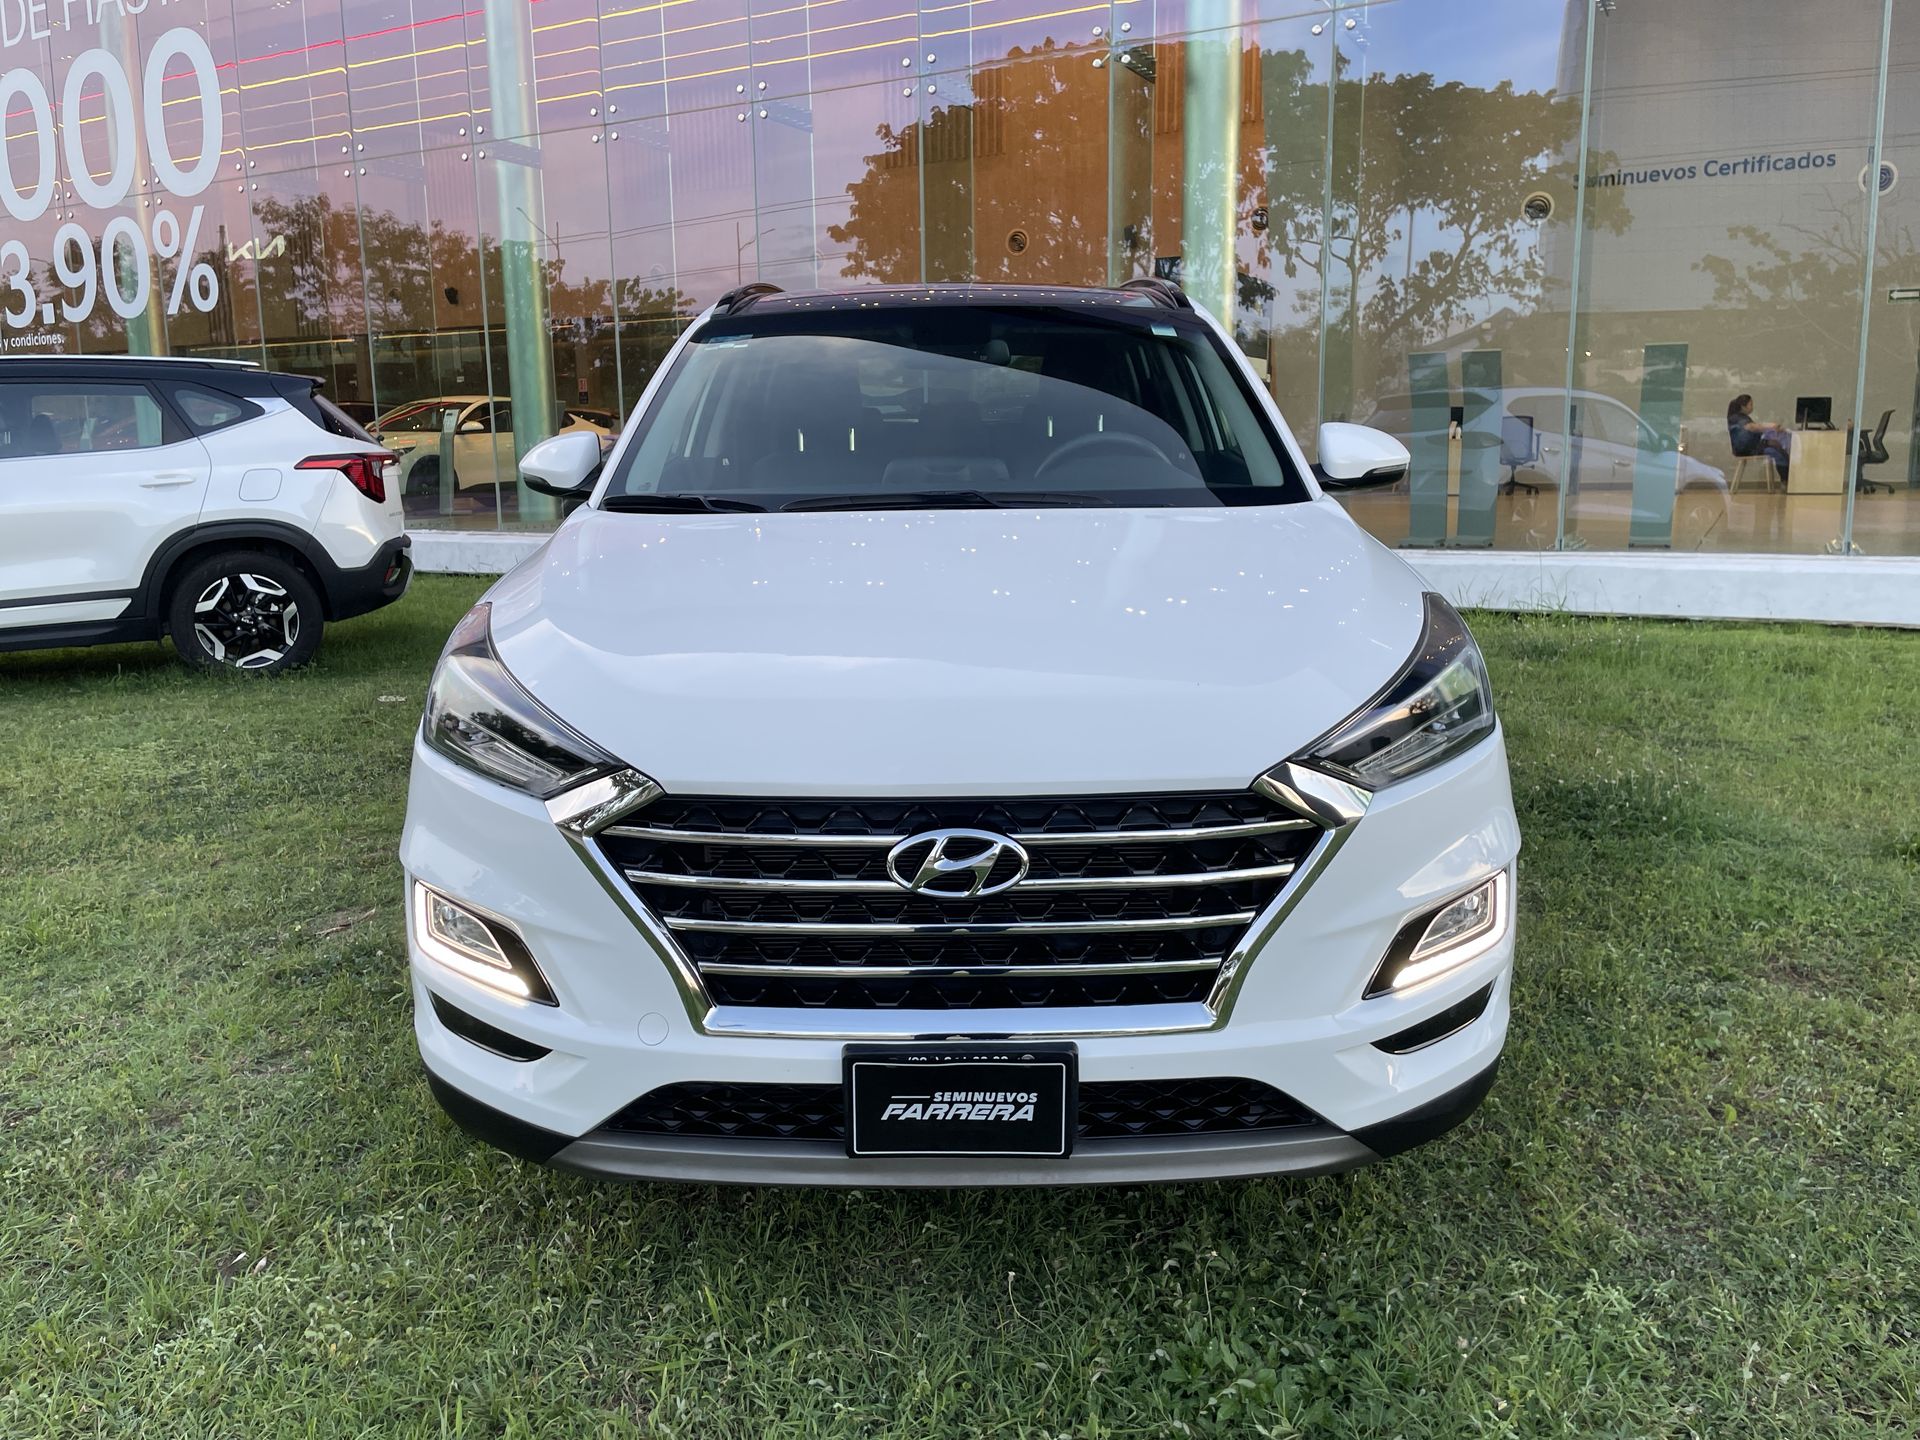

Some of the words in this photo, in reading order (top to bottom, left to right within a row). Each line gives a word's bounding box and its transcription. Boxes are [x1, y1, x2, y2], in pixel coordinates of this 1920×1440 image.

[1703, 152, 1837, 177] Certificados
[0, 204, 219, 329] 3.90%
[932, 1091, 1039, 1103] SEMINUEVOS
[880, 1103, 1035, 1121] FARRERA
